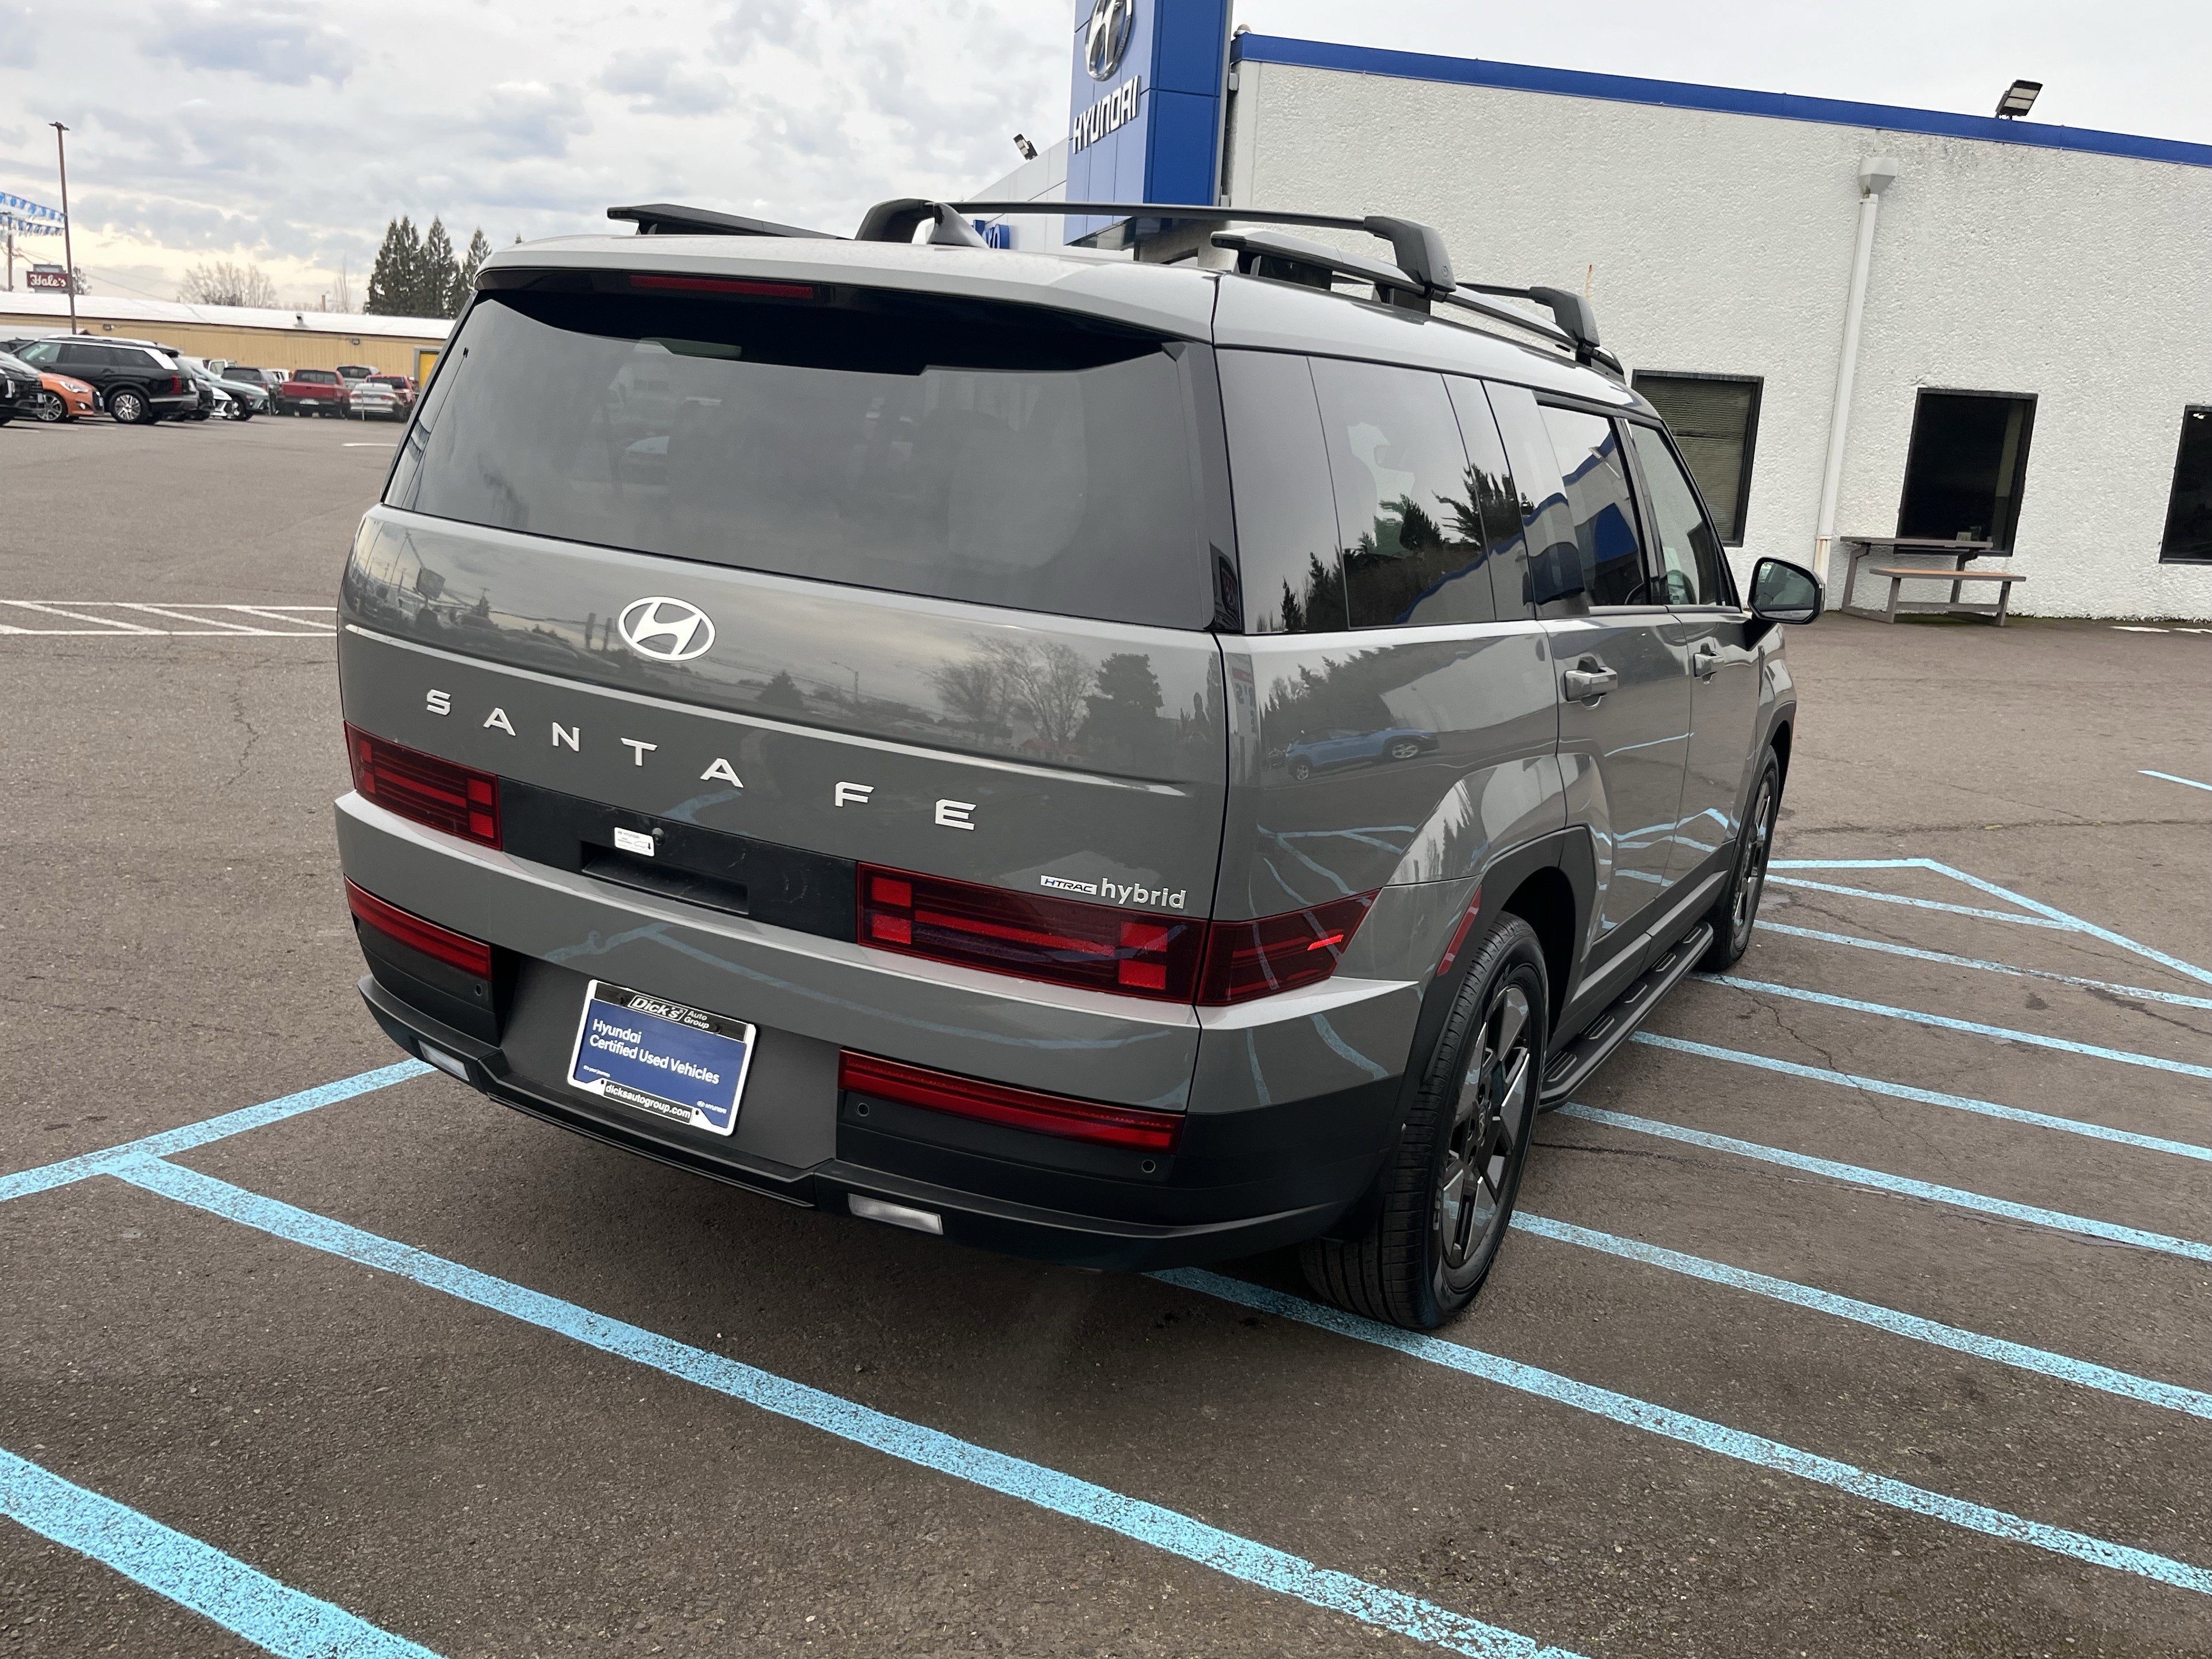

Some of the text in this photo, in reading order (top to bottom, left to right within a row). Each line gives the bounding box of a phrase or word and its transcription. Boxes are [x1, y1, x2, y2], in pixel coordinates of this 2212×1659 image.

[1073, 75, 1141, 154] HYUNDAI
[30, 274, 66, 287] Hale's
[426, 689, 977, 831] SANTA FE
[1044, 877, 1187, 910] HTRAC hybrid
[632, 997, 681, 1019] Dick's
[684, 1016, 710, 1029] Group
[687, 1011, 708, 1021] Auto
[592, 1018, 642, 1045] Hyundai
[589, 1034, 720, 1085] Certified Used Vehicles
[605, 1084, 691, 1119] dicksautogroup.com
